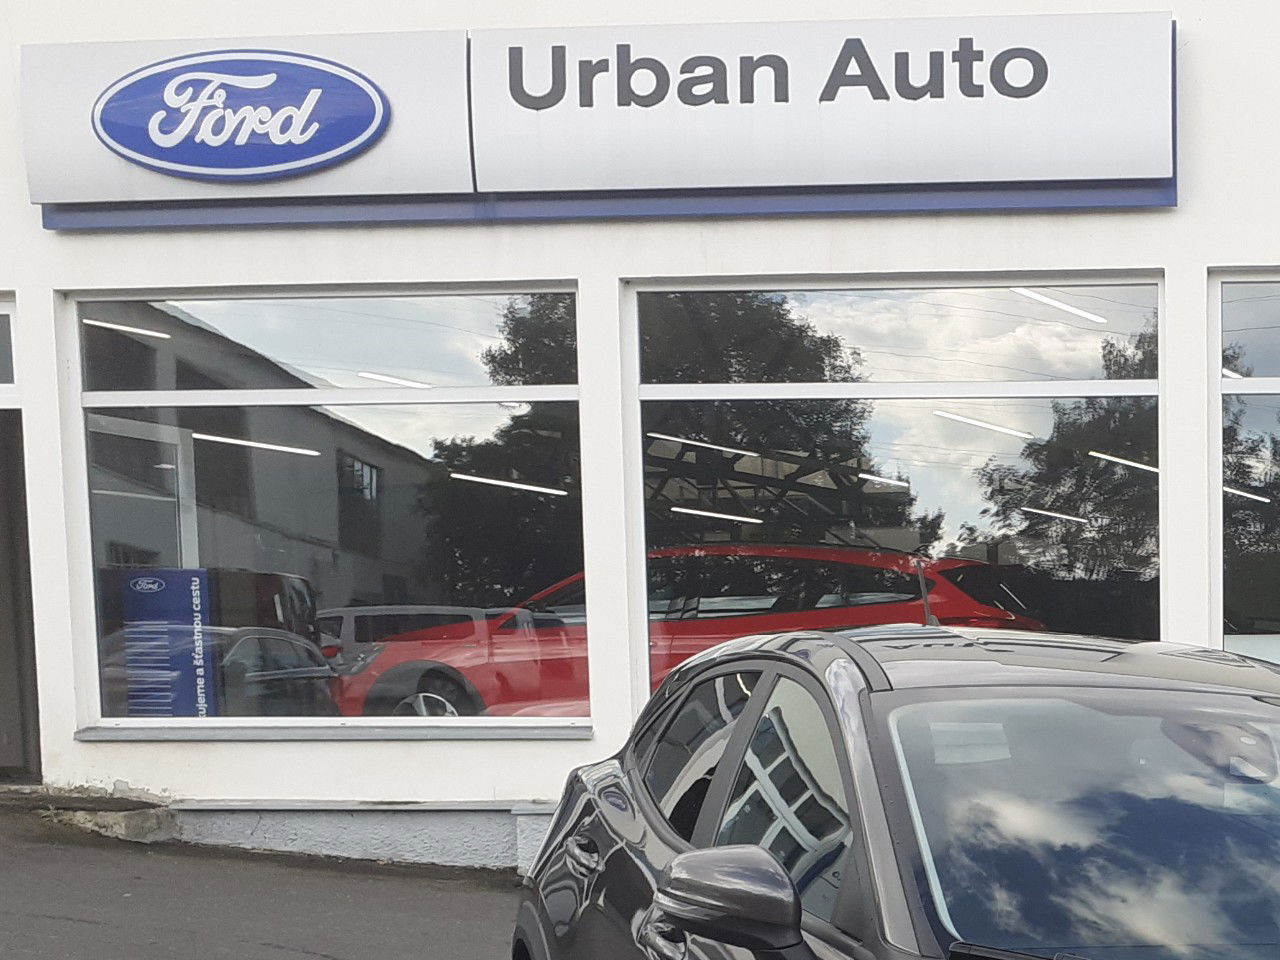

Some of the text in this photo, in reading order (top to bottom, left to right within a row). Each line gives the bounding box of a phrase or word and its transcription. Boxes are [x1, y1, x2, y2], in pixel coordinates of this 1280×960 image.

[508, 38, 1048, 111] Urban Auto
[148, 71, 323, 148] Ford
[136, 578, 159, 591] Ford
[190, 577, 202, 611] cestu
[191, 612, 204, 666] šťastnou
[195, 667, 205, 675] a
